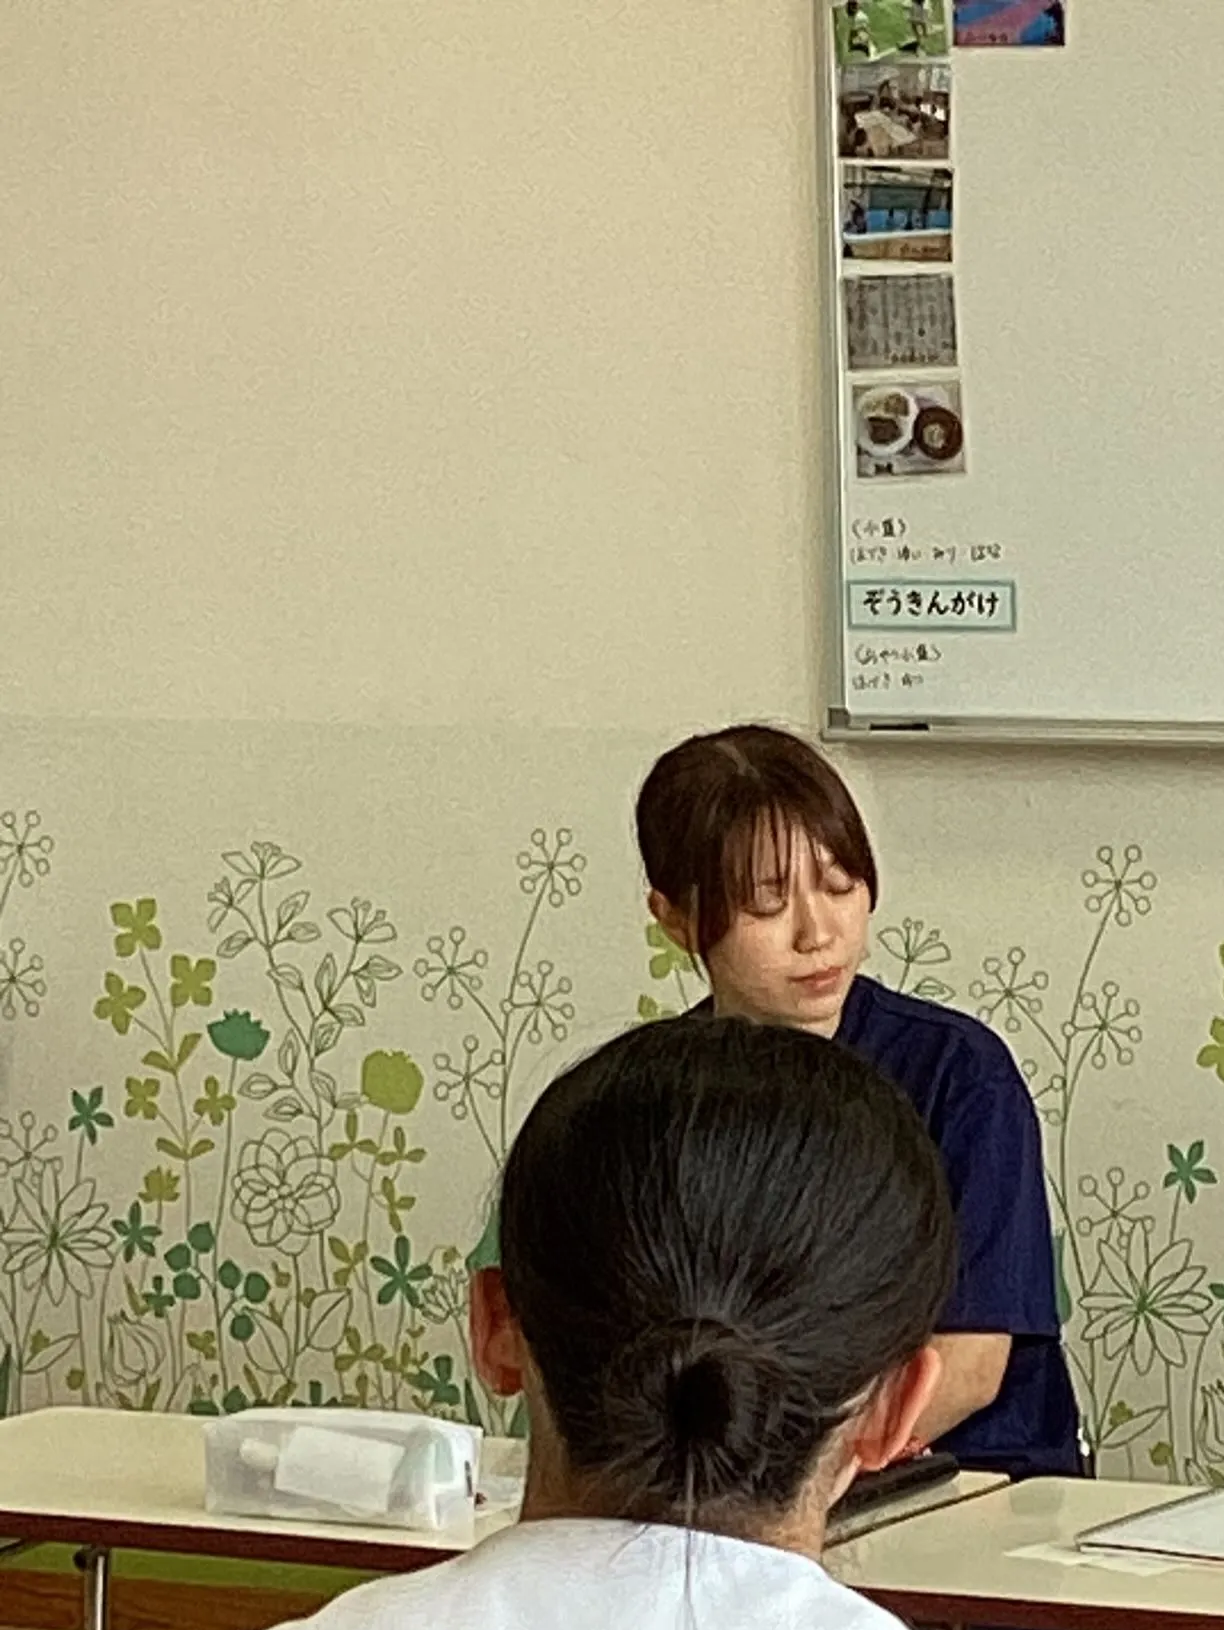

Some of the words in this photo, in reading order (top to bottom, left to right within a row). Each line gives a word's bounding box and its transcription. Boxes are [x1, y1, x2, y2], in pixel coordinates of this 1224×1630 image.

[863, 588, 1000, 618] ぞうきんがけ
